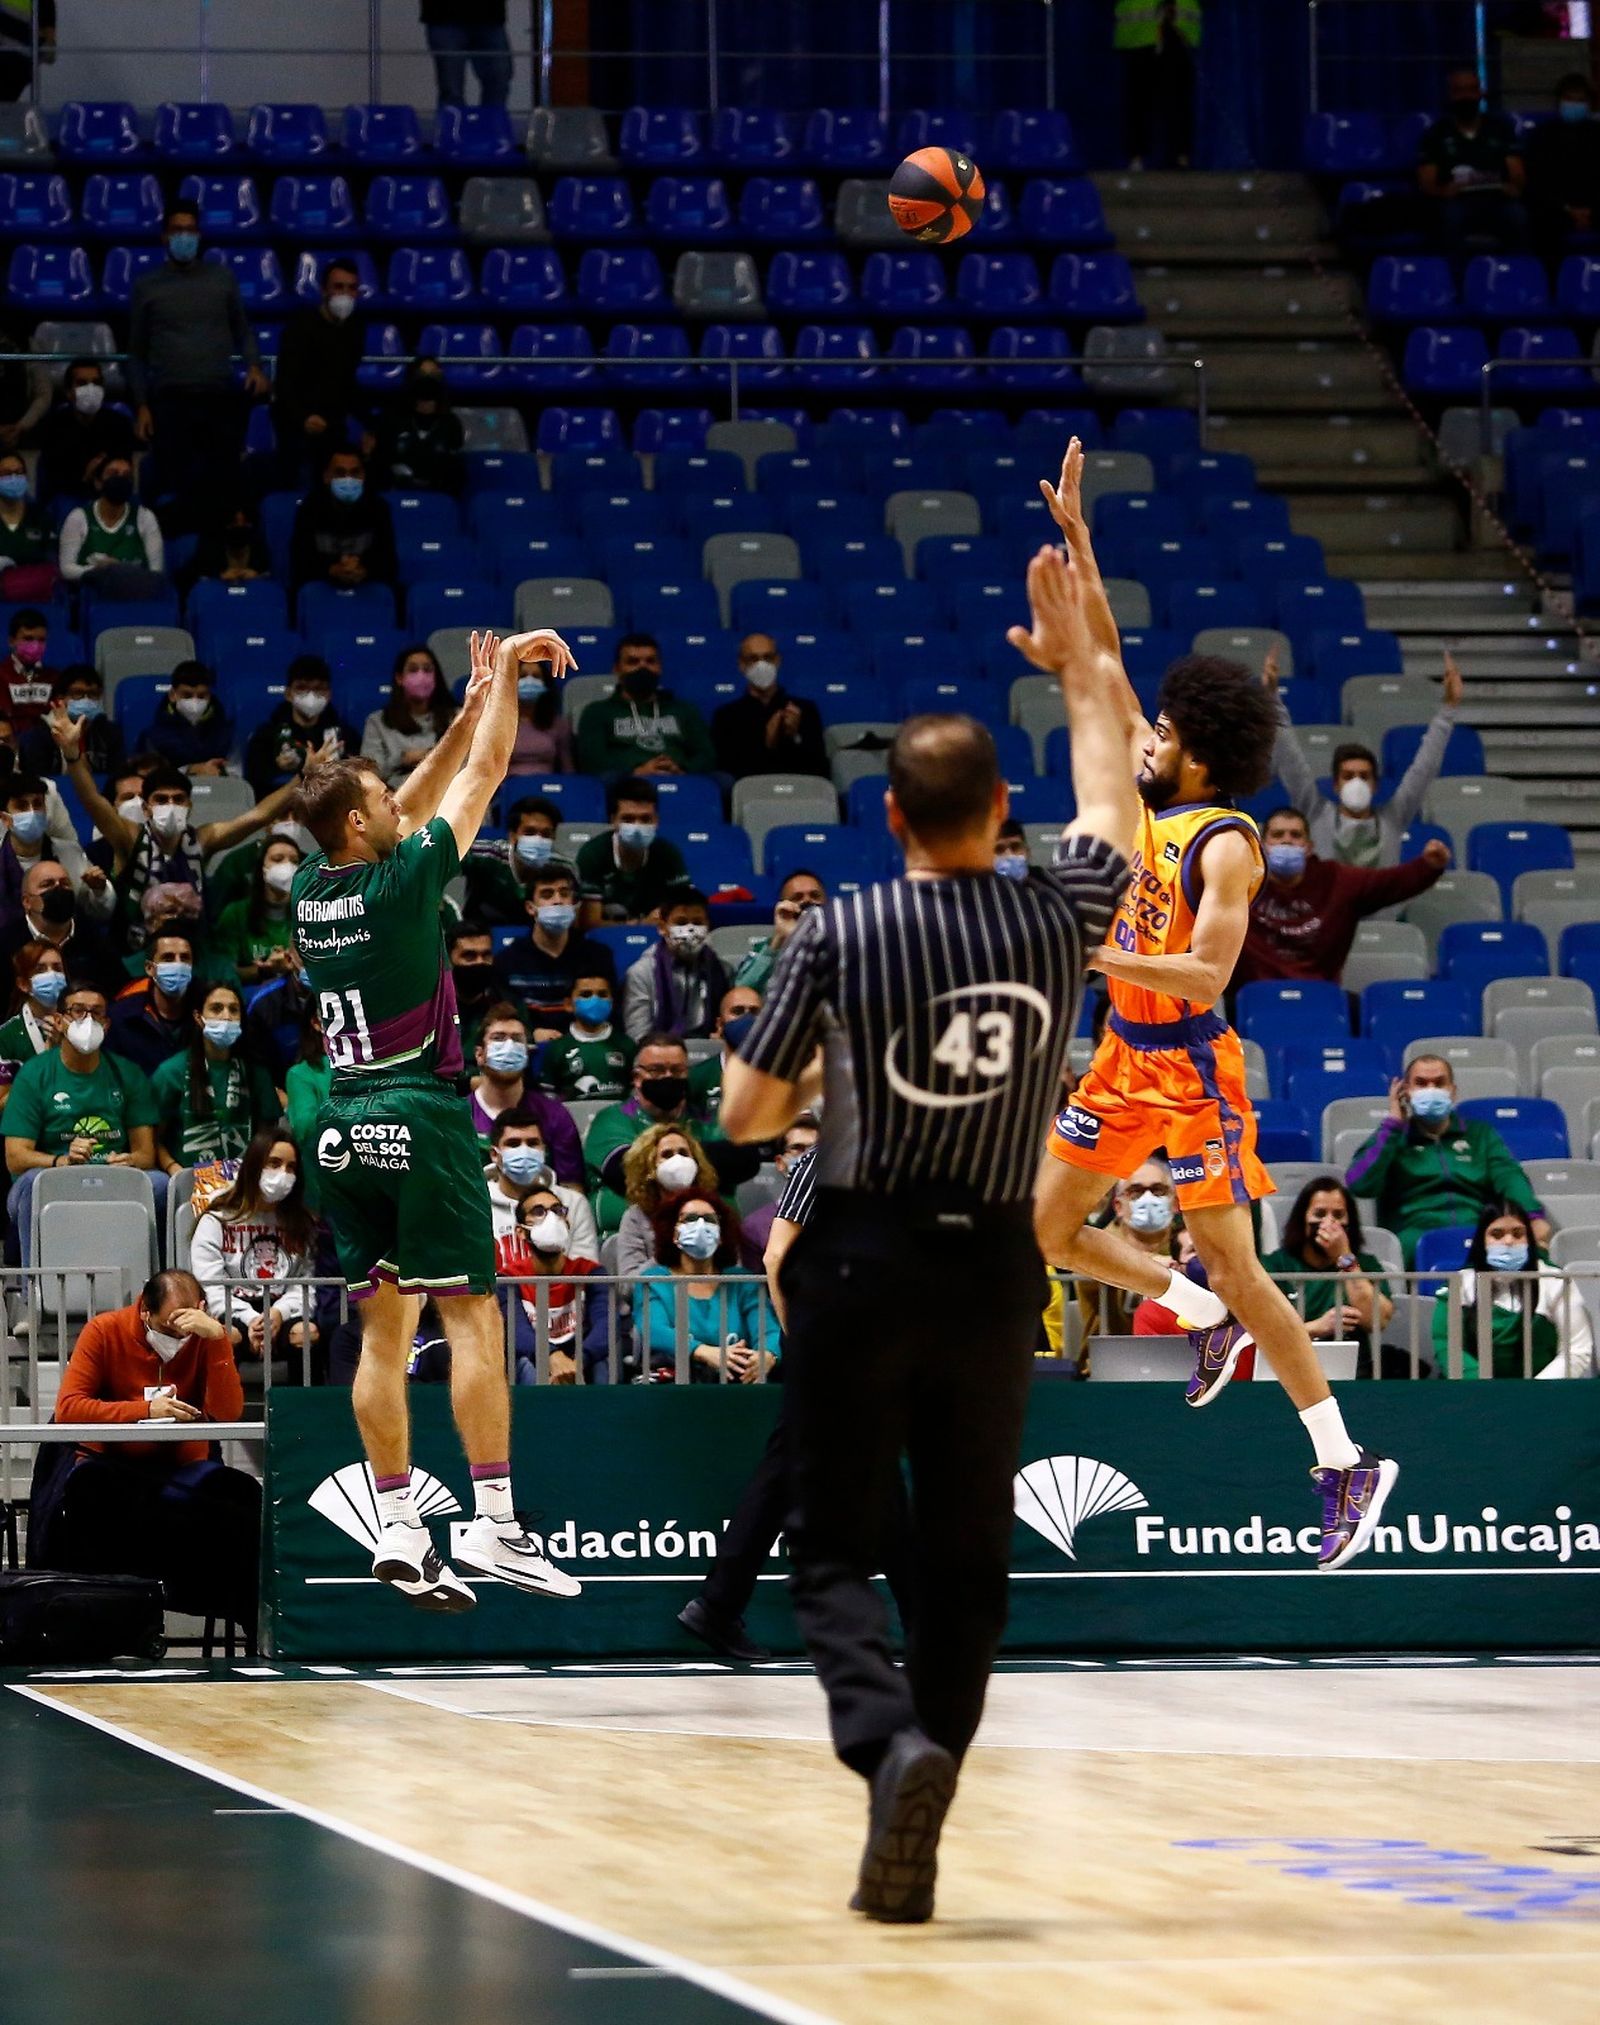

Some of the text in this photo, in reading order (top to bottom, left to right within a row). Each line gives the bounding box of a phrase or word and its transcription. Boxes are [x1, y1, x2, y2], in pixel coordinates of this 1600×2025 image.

[320, 988, 374, 1068] 21
[932, 1011, 1013, 1077] 43
[350, 1123, 412, 1141] COSTA
[352, 1142, 411, 1157] DEL SOL
[450, 1519, 718, 1559] Fdación
[1136, 1506, 1600, 1562] FundacnUnicaja
